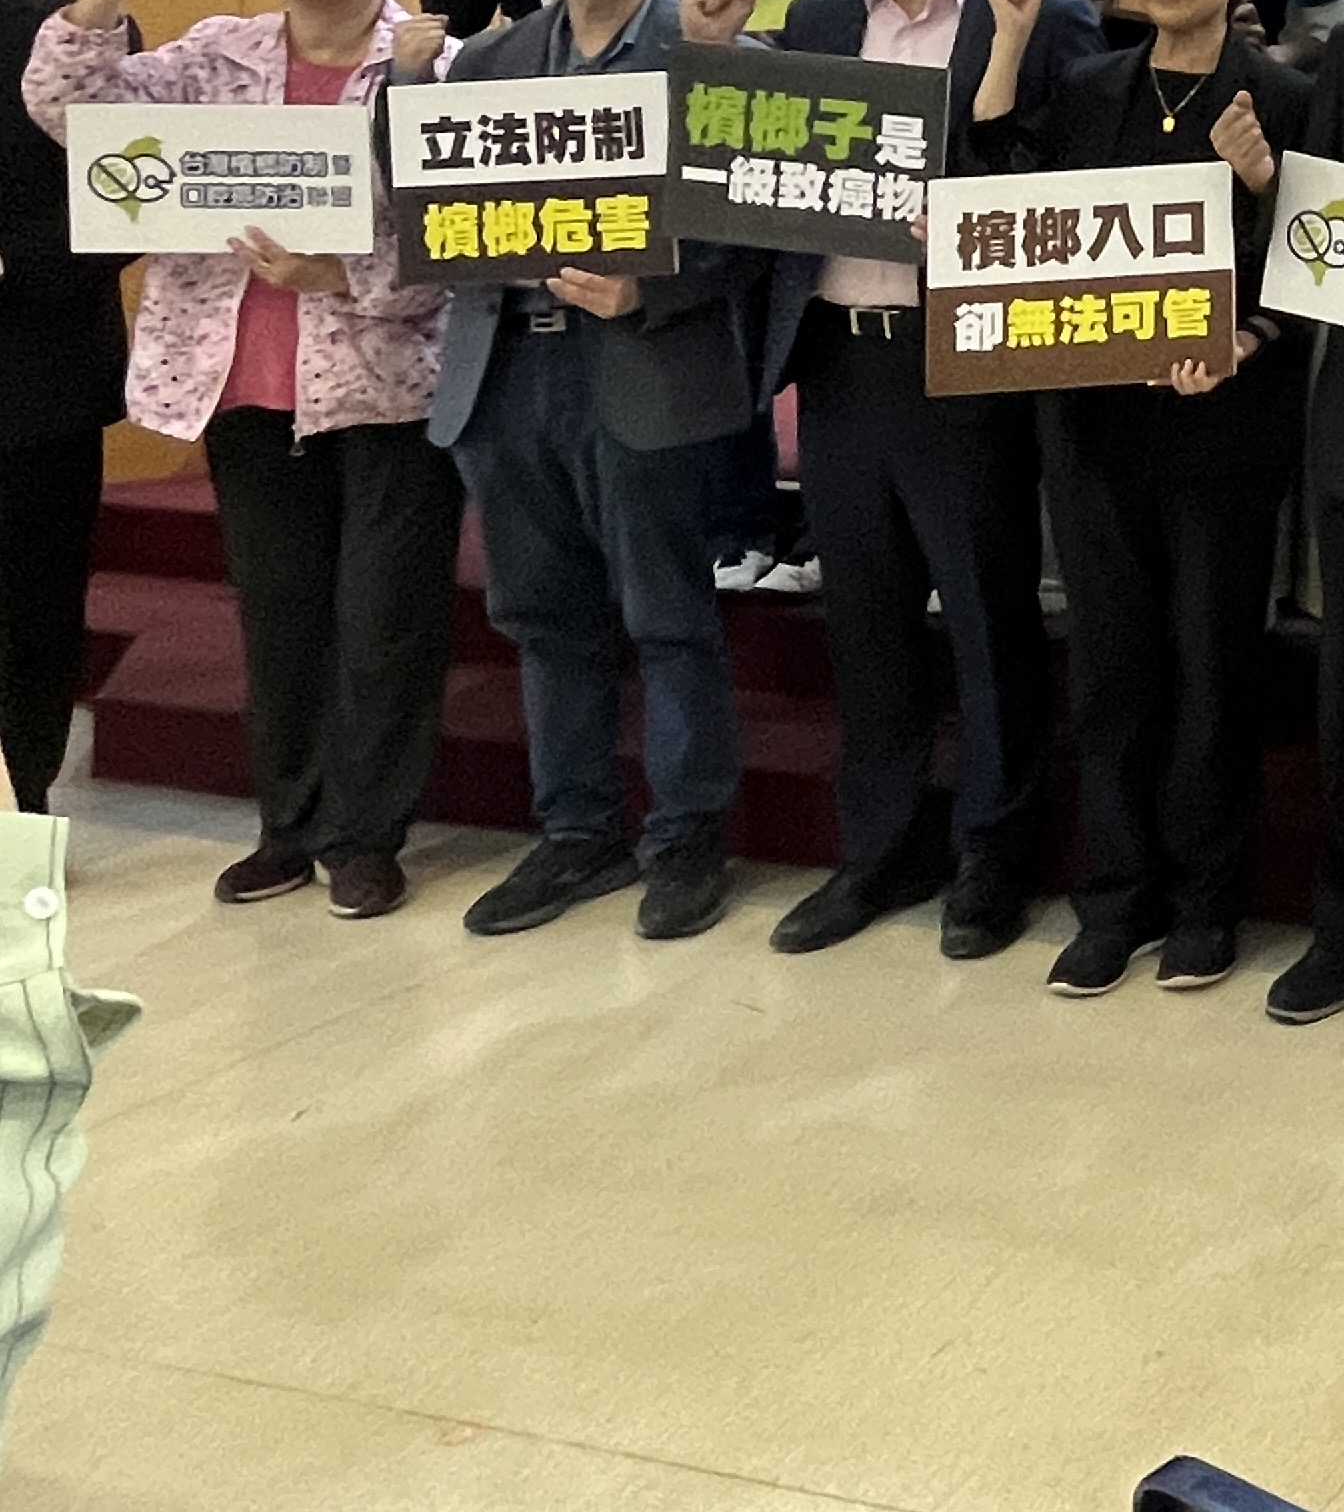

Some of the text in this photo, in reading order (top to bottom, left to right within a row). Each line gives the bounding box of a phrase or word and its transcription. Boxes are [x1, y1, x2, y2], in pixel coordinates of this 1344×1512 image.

[420, 105, 645, 170] 立法防制
[686, 82, 928, 170] 檳榔子是
[681, 156, 925, 223] 一級致癌物
[423, 194, 651, 260] 檳榔危害
[956, 200, 1206, 273] 檳榔入口
